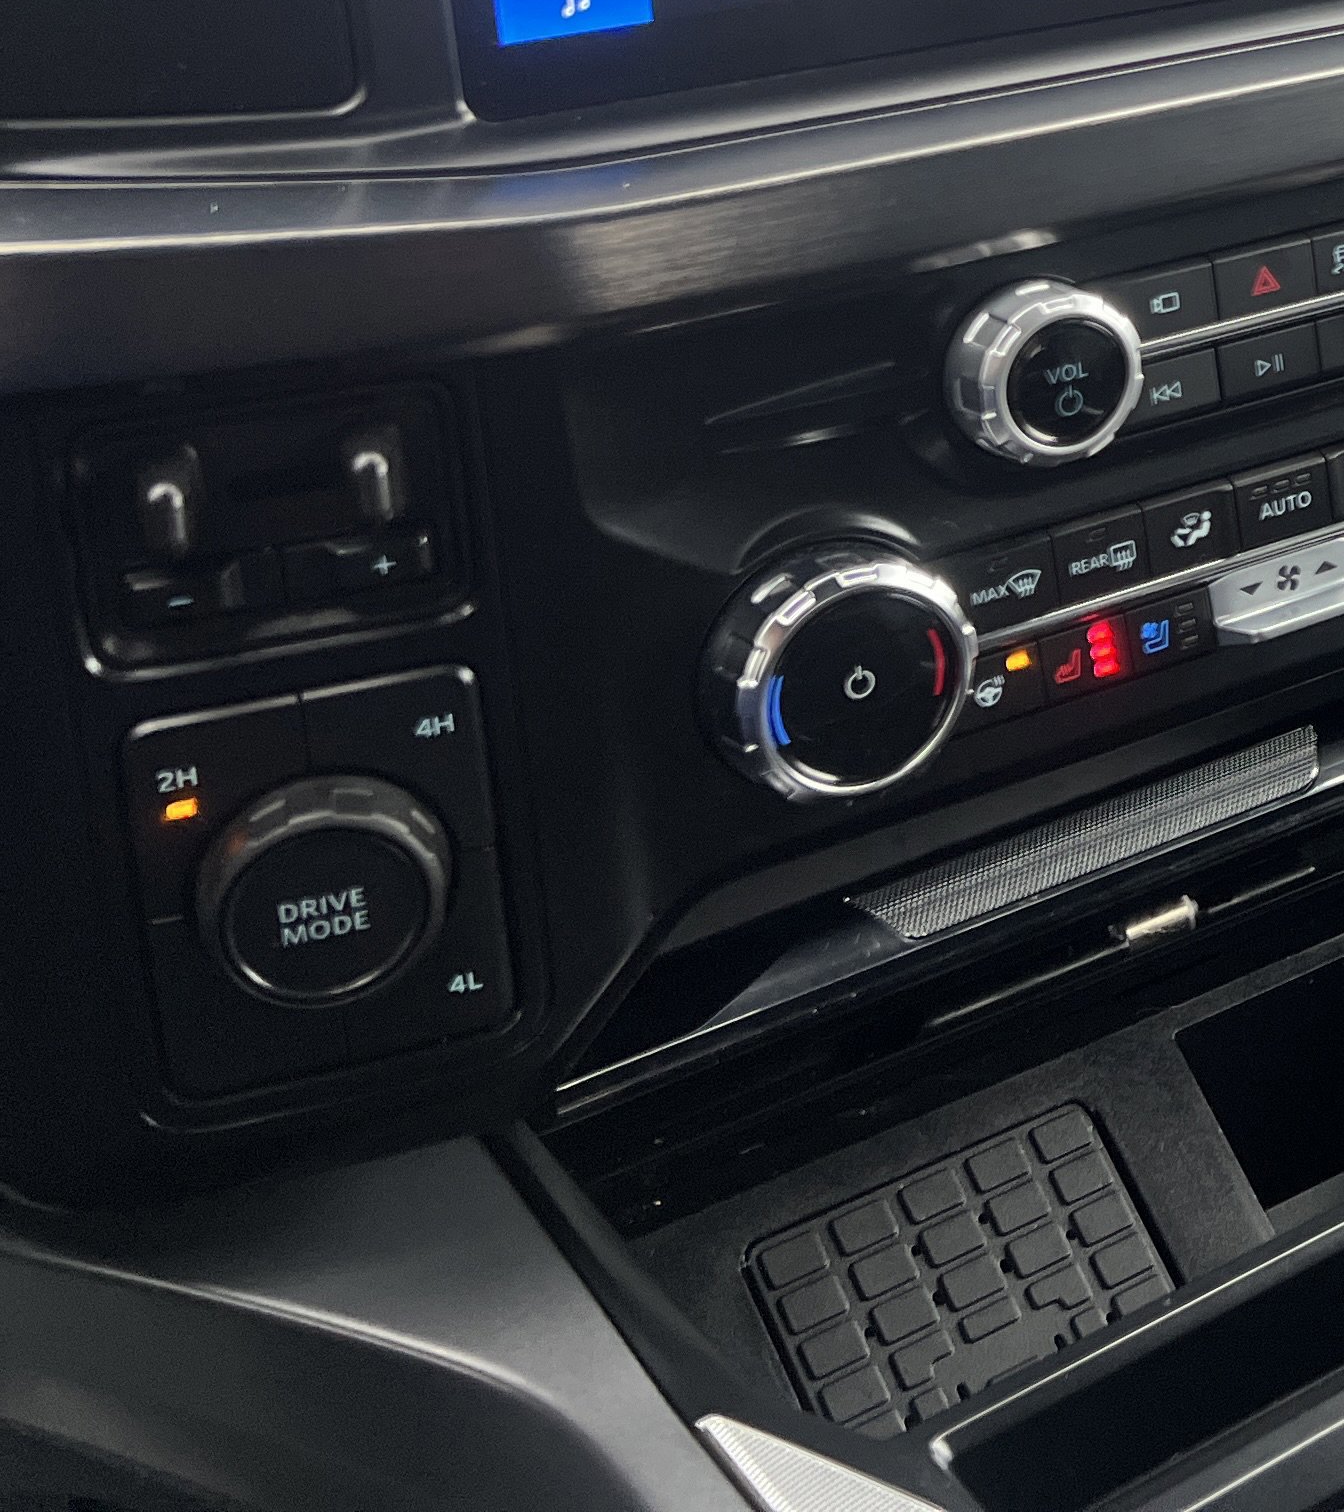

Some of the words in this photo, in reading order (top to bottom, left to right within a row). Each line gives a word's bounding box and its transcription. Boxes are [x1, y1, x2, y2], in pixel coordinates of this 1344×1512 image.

[1044, 360, 1090, 386] VOL
[1258, 489, 1313, 521] AUTO
[1068, 551, 1109, 577] REAR
[970, 581, 1011, 607] MAX
[413, 712, 456, 739] 4H
[156, 764, 200, 793] 2H
[277, 886, 368, 925] DRIVE
[280, 909, 371, 948] MODE
[447, 971, 485, 994] 4L
